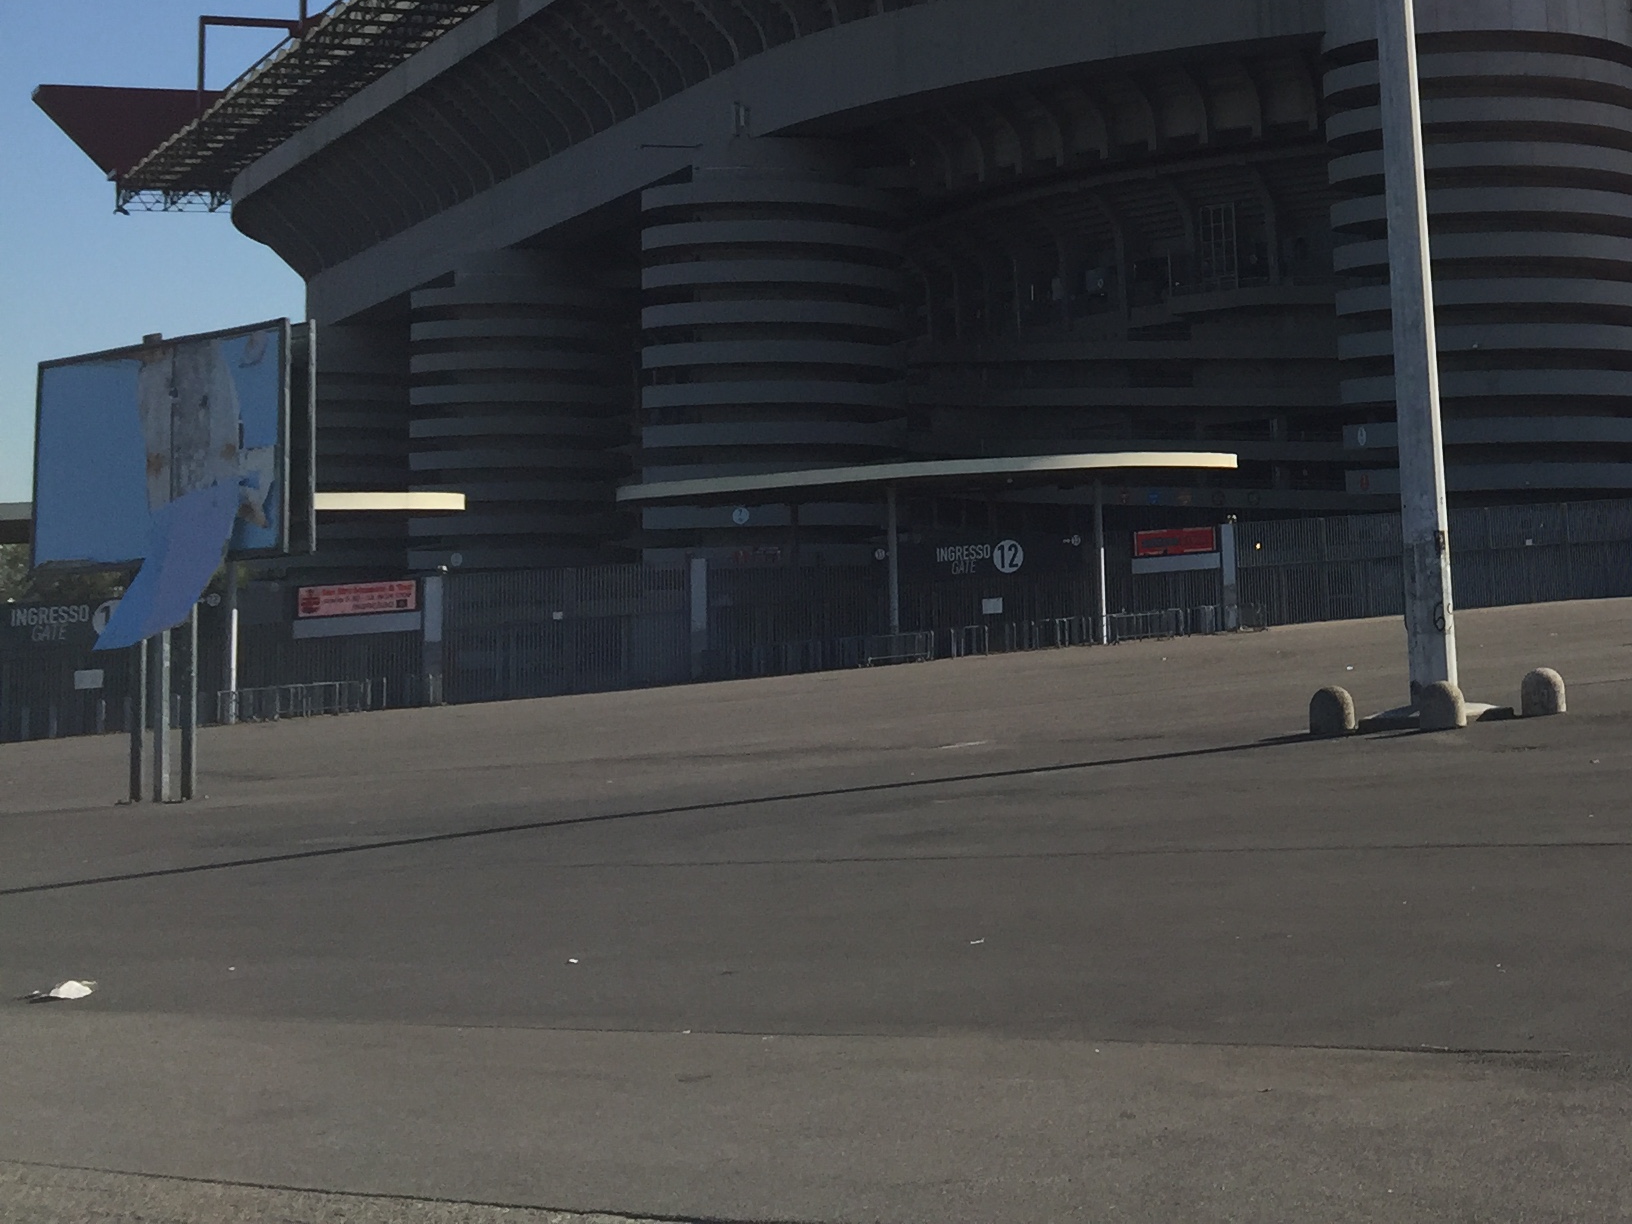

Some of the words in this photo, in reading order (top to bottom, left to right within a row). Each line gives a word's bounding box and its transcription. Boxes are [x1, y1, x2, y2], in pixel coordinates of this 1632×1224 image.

[936, 543, 991, 563] INGRESSO
[996, 543, 1019, 569] 12
[951, 559, 976, 575] GATE
[10, 604, 89, 627] INGRESSO
[31, 624, 68, 643] GATE
